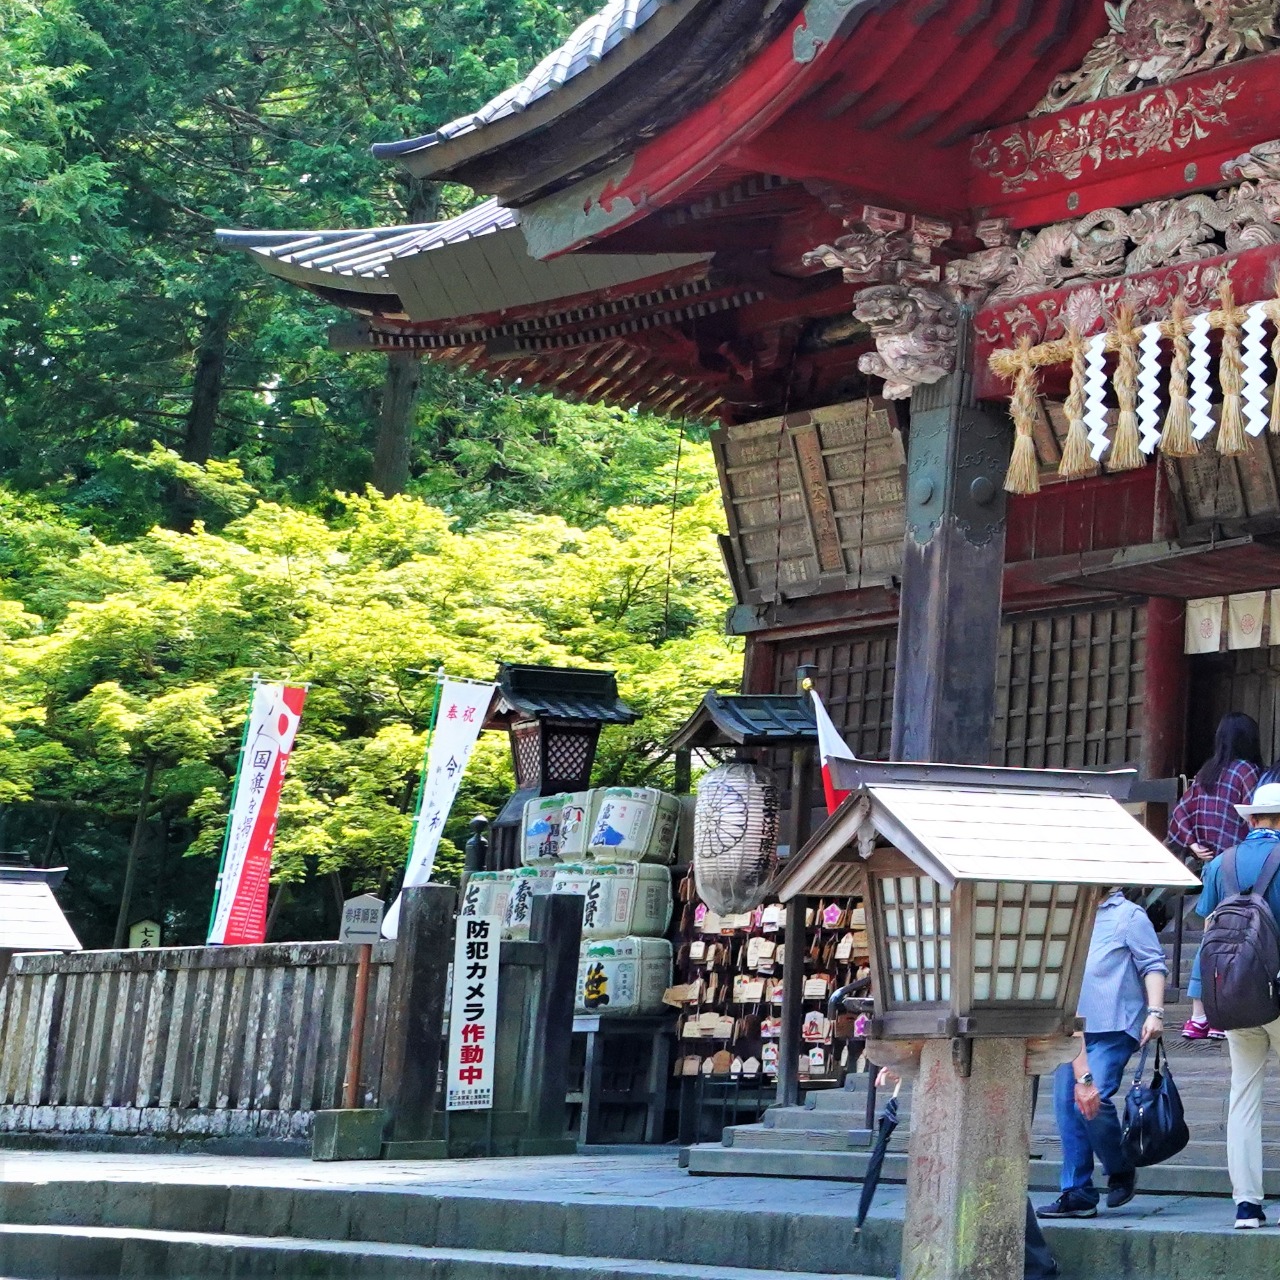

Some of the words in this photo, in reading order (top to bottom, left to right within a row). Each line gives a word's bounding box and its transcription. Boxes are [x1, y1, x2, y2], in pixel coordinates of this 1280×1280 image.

[458, 920, 491, 1085] 防犯カメラ作動中
